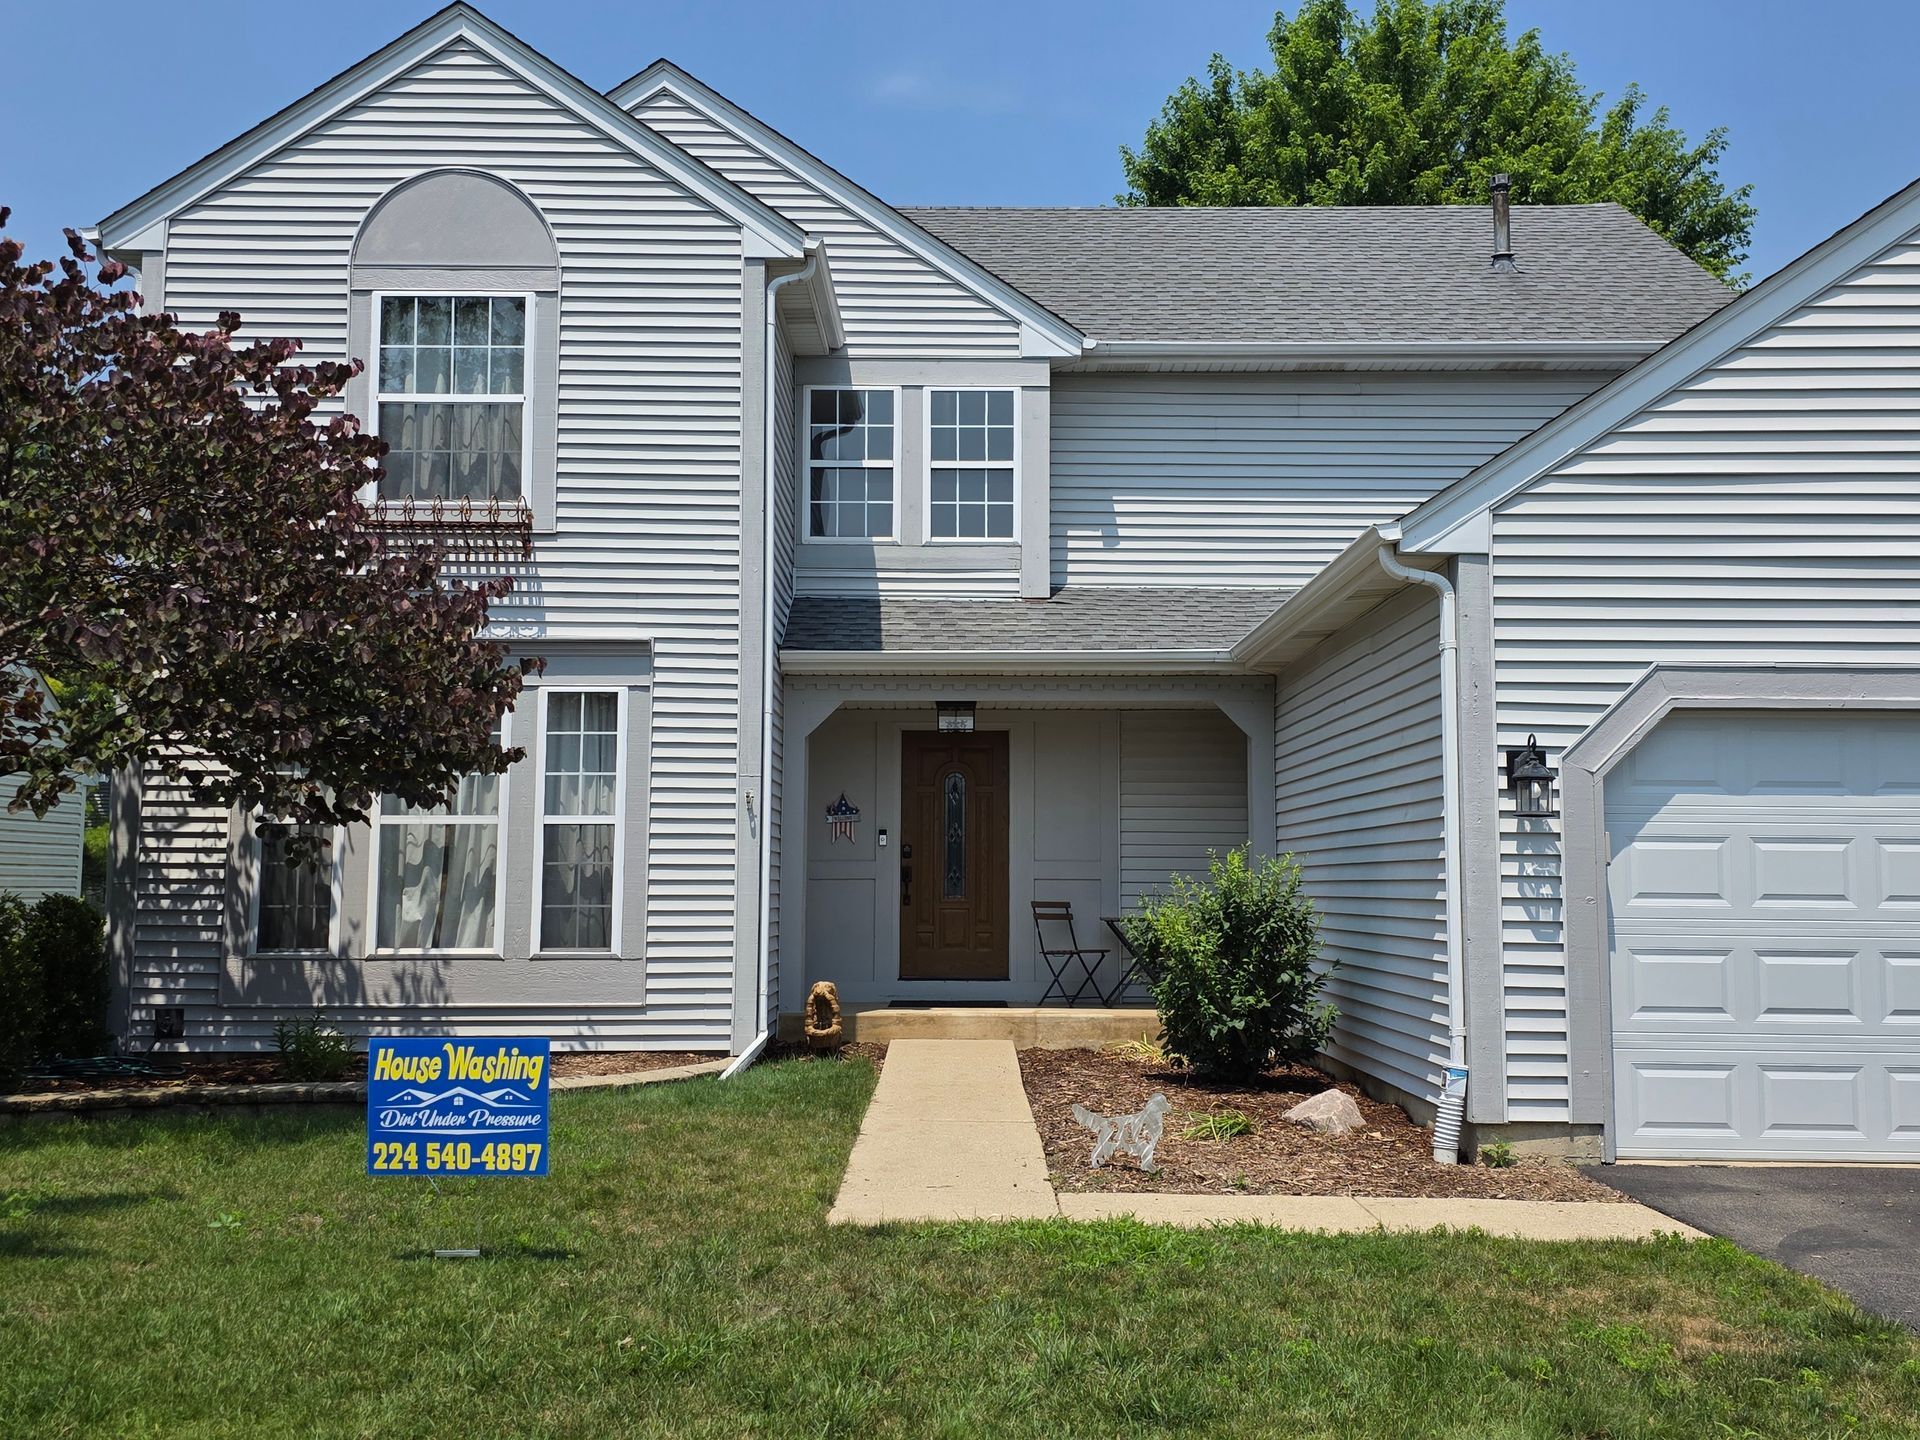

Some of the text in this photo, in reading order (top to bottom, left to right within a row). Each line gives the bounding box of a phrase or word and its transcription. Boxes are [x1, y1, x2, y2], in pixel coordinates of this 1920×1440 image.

[374, 1043, 545, 1090] House Washing
[379, 1108, 542, 1127] Dirt Under Pressure
[373, 1142, 542, 1171] 224 540-4897
